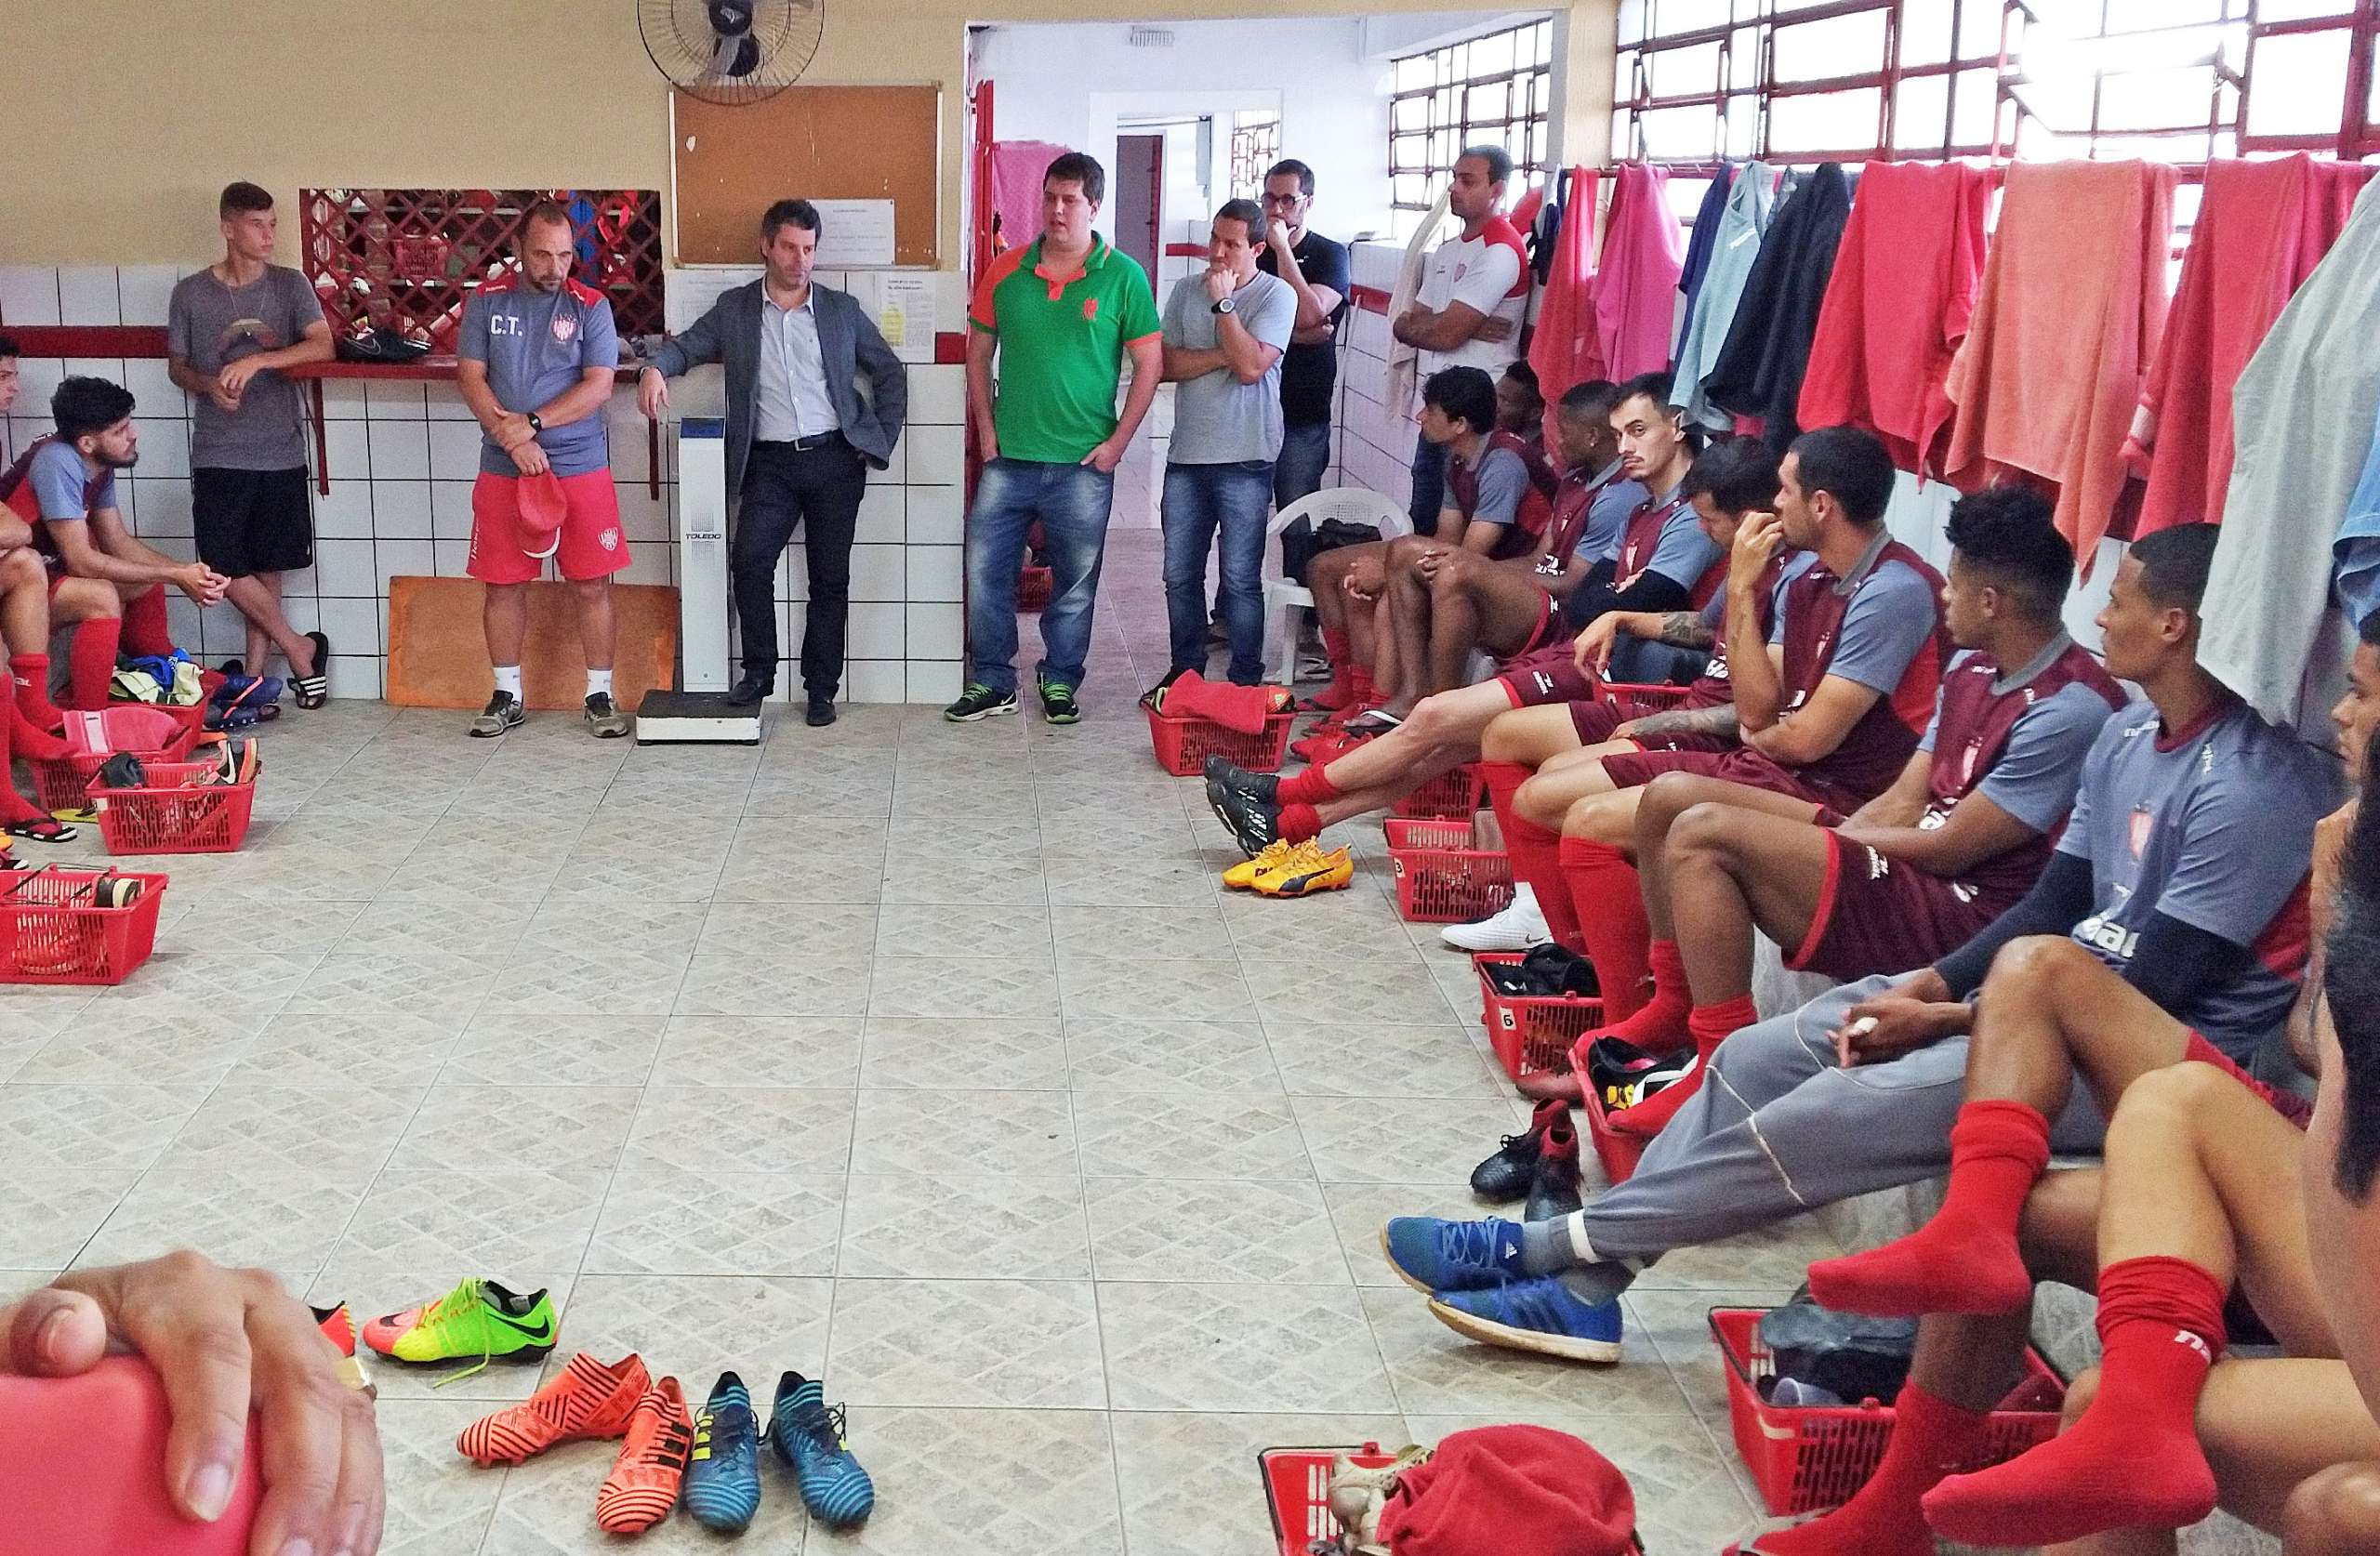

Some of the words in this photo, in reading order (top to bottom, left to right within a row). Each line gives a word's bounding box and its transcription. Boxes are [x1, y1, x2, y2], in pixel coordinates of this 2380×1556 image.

[491, 314, 522, 336] C.T.
[1395, 862, 1403, 874] 3
[1503, 1014, 1514, 1026] 6
